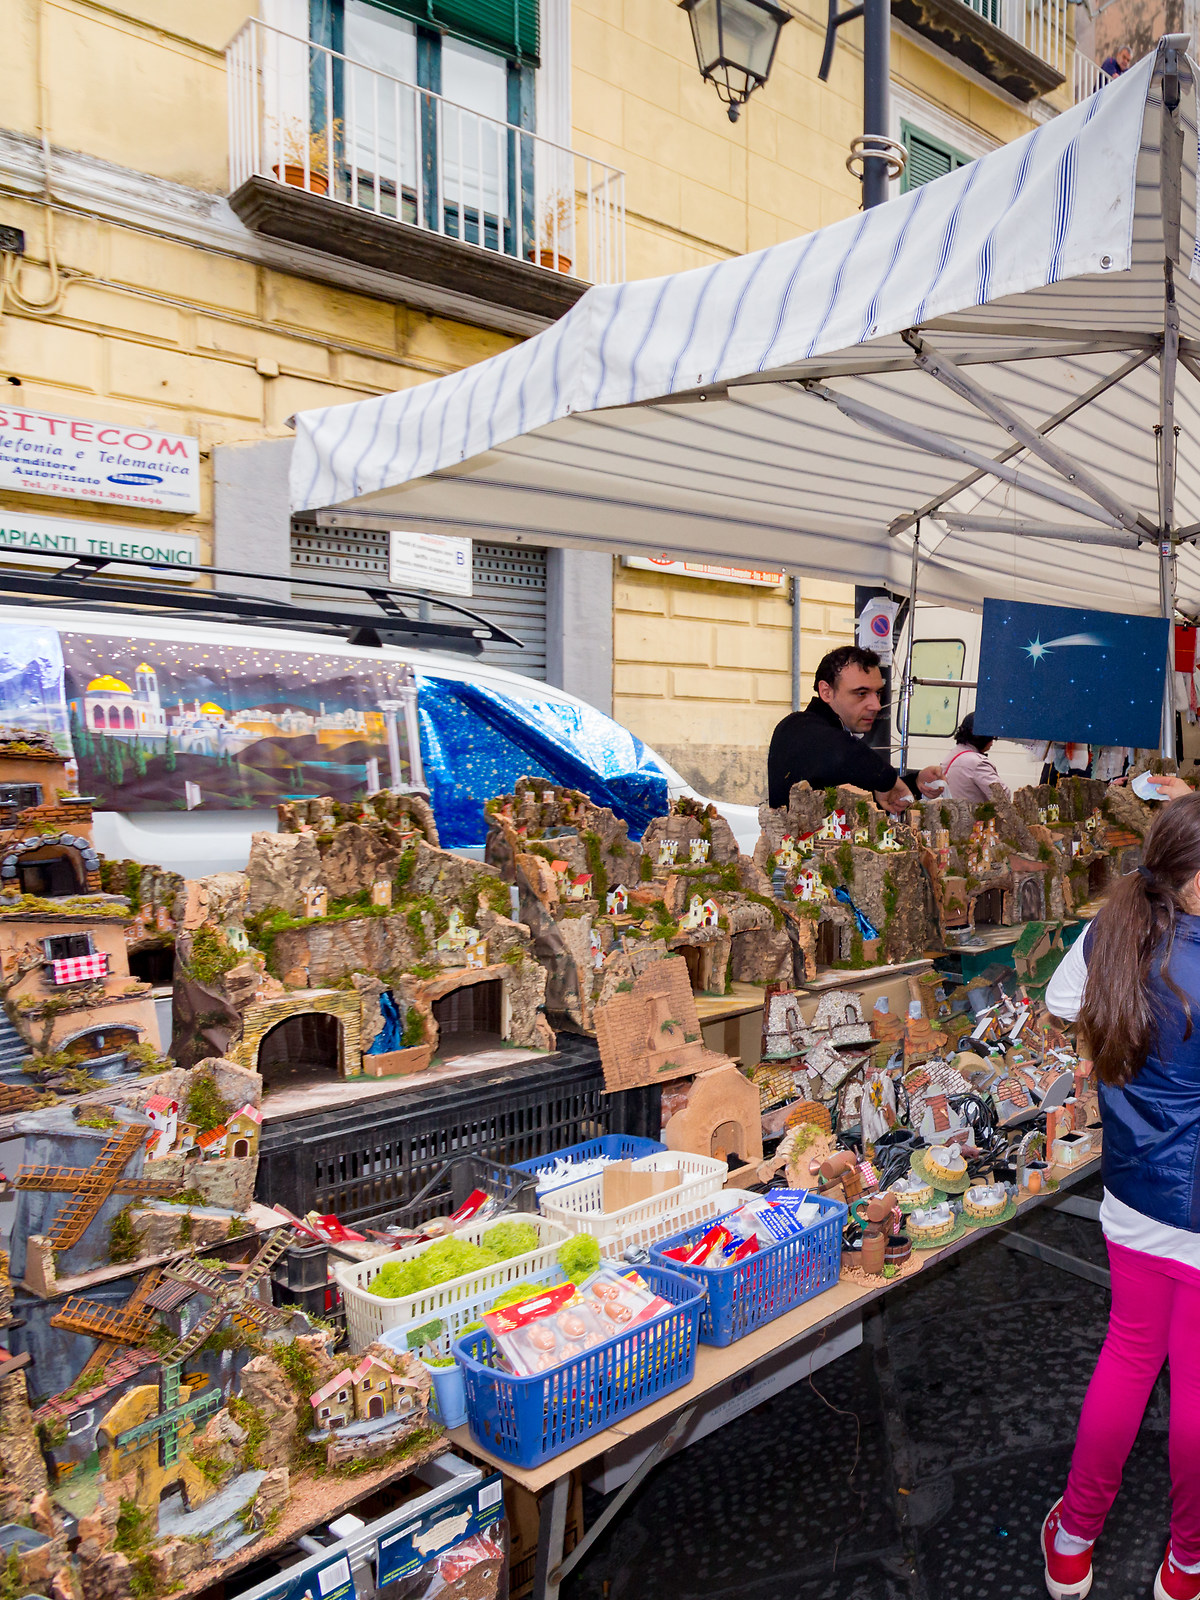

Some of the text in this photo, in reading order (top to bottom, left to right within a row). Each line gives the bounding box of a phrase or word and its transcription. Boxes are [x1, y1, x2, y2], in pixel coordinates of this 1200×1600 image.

[76, 451, 85, 459] e
[99, 450, 190, 475] Telematica
[12, 466, 101, 485] Autorizzato
[87, 539, 192, 565] TELEFONICI
[456, 551, 464, 565] B
